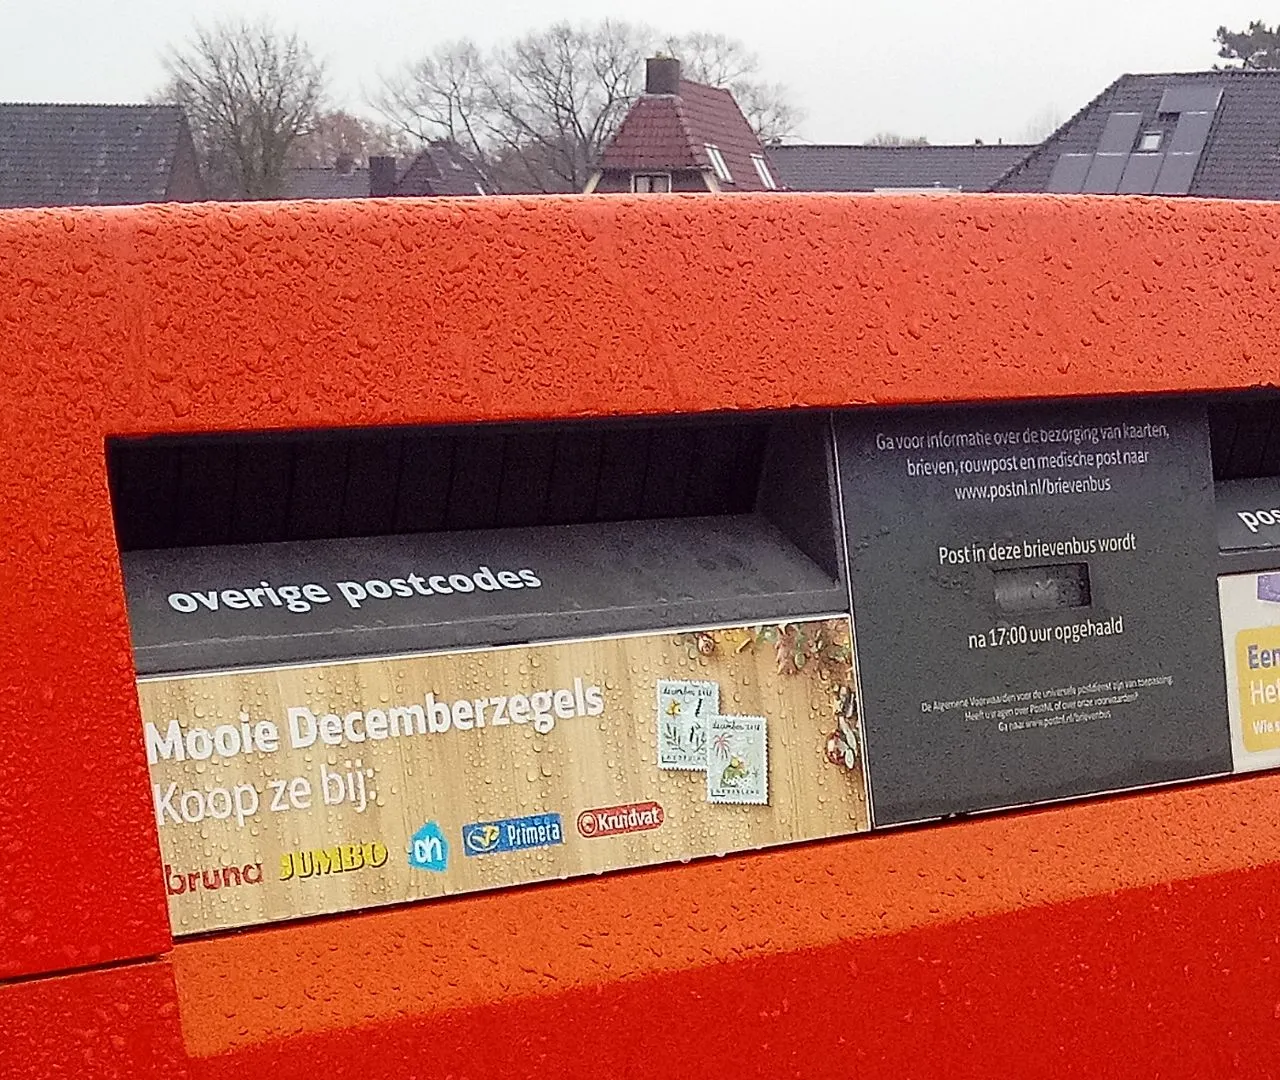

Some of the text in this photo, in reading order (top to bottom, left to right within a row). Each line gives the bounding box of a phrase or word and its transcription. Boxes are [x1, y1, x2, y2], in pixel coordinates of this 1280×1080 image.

[876, 423, 1170, 450] Ga voor informatie over de bezorging van kaarten,
[907, 450, 1149, 476] brieven, rouwpost en medische post naar
[955, 476, 1111, 502] www.postnl.nl/brievenbus
[938, 532, 1136, 564] Post in deze brievenbus wordt
[168, 566, 542, 613] overige postcodes
[969, 616, 1124, 649] na 17:00 uur opgehaald
[145, 677, 605, 765] Mooie Decemberzegels
[1252, 719, 1273, 734] Wie
[154, 759, 378, 826] Koop ze bij:
[507, 822, 561, 847] Primera
[596, 807, 660, 832] Kruidvat
[279, 840, 389, 881] JUMBO
[165, 863, 265, 896] bruna
